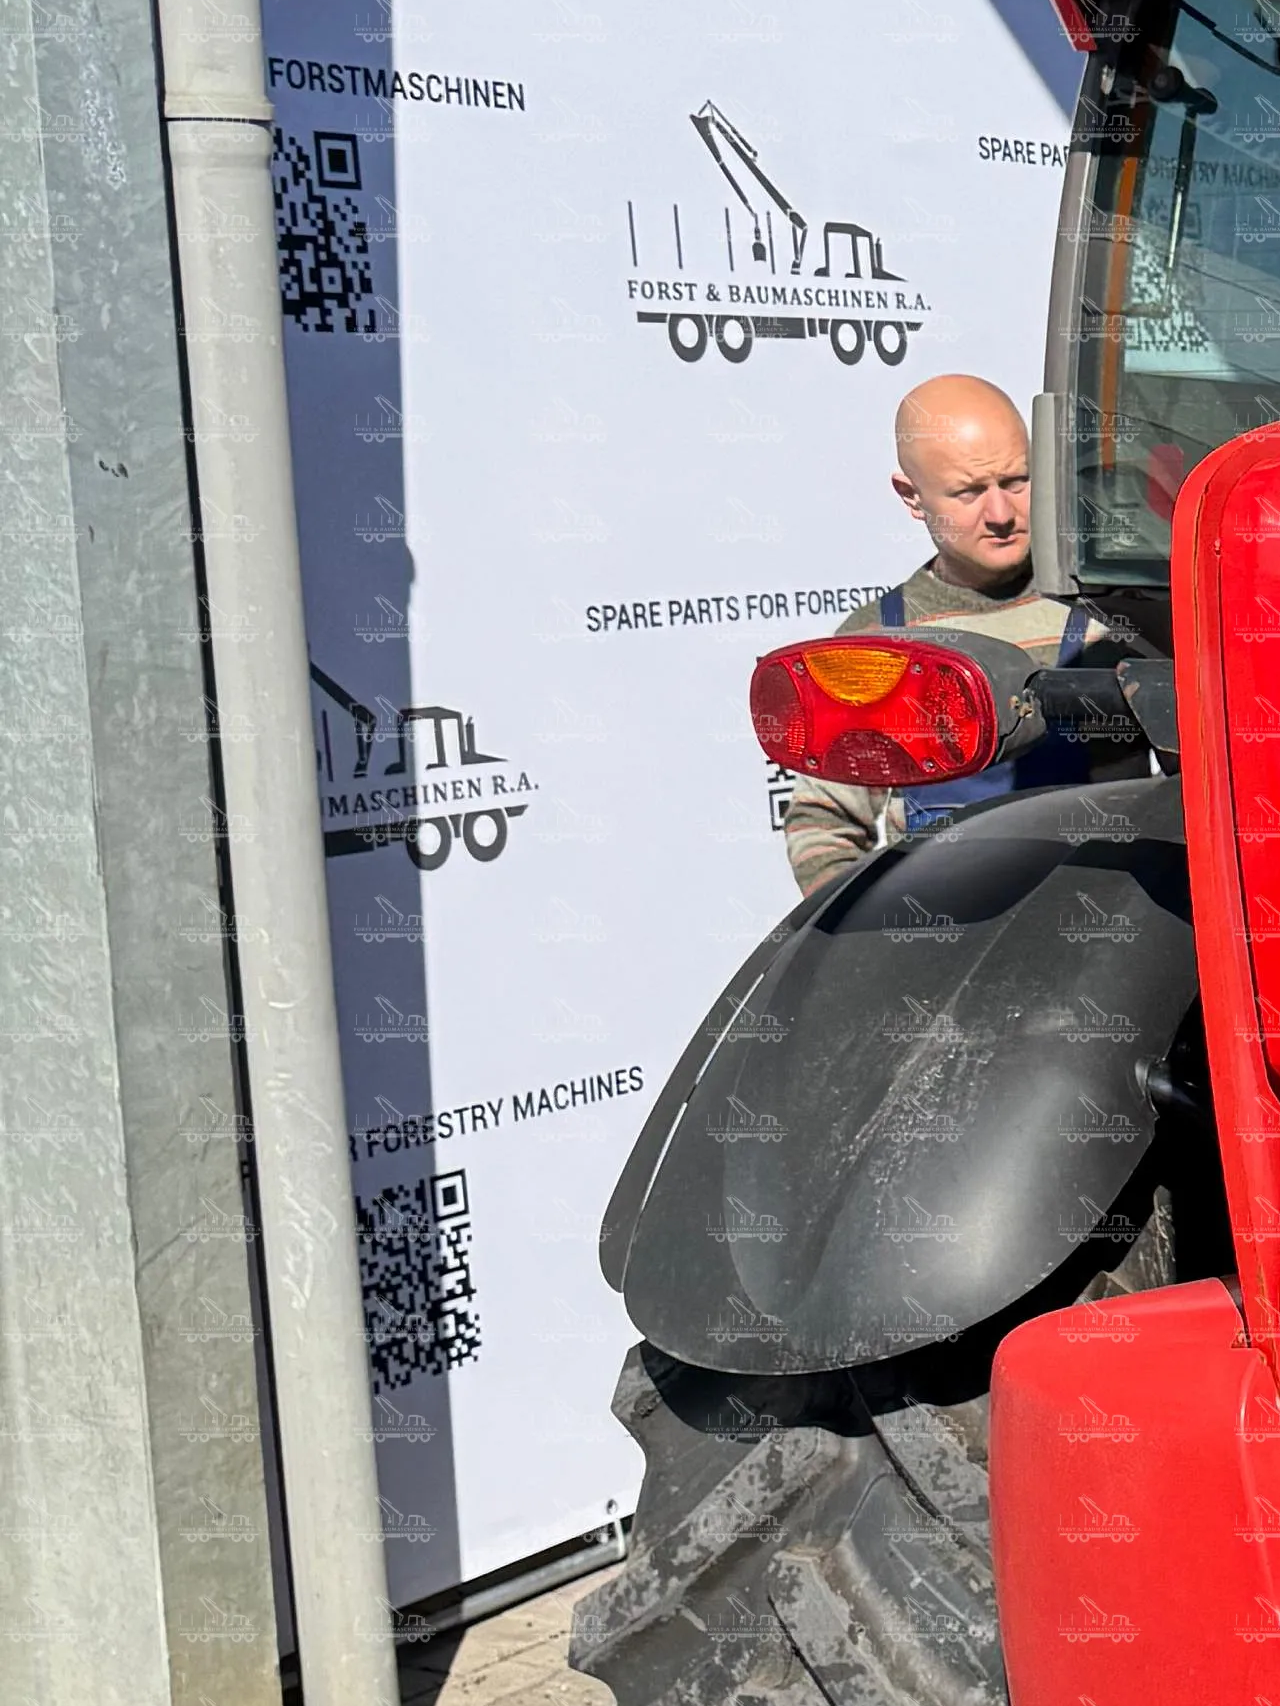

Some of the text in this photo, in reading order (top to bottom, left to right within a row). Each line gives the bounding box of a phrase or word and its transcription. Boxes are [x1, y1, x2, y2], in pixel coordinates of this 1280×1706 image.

[268, 57, 526, 112] FORSTMASCHINEN
[978, 136, 1037, 165] SPARE
[627, 279, 932, 312] FORST & BAUMASCHINEN R.A.
[587, 586, 892, 632] SPARE PARTS FOR FOREST
[320, 771, 540, 818] MASCHINEN R.A.
[366, 1097, 505, 1159] FORESTRY
[511, 1065, 645, 1123] MACHINES
